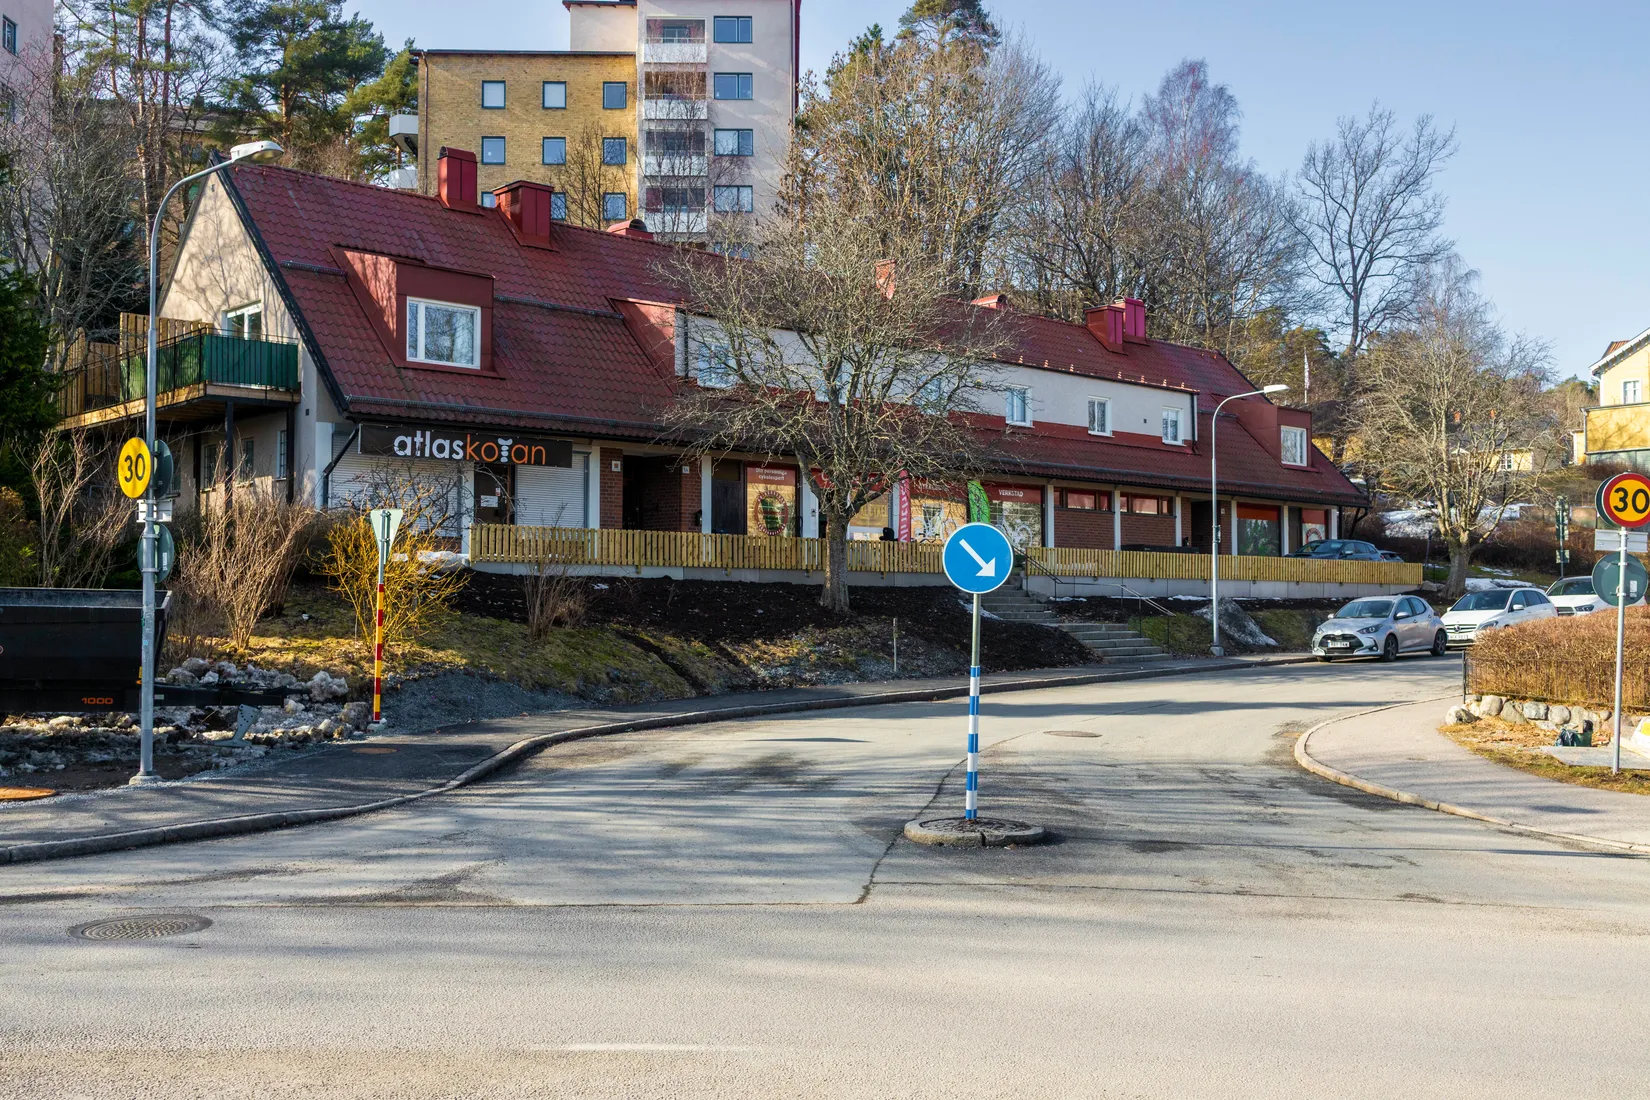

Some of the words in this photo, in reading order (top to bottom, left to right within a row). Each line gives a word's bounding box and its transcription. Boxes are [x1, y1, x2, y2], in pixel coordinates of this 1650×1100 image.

[124, 453, 146, 483] 30
[998, 489, 1024, 498] VERKSTAD
[1613, 487, 1650, 514] 30
[80, 697, 114, 705] 1000
